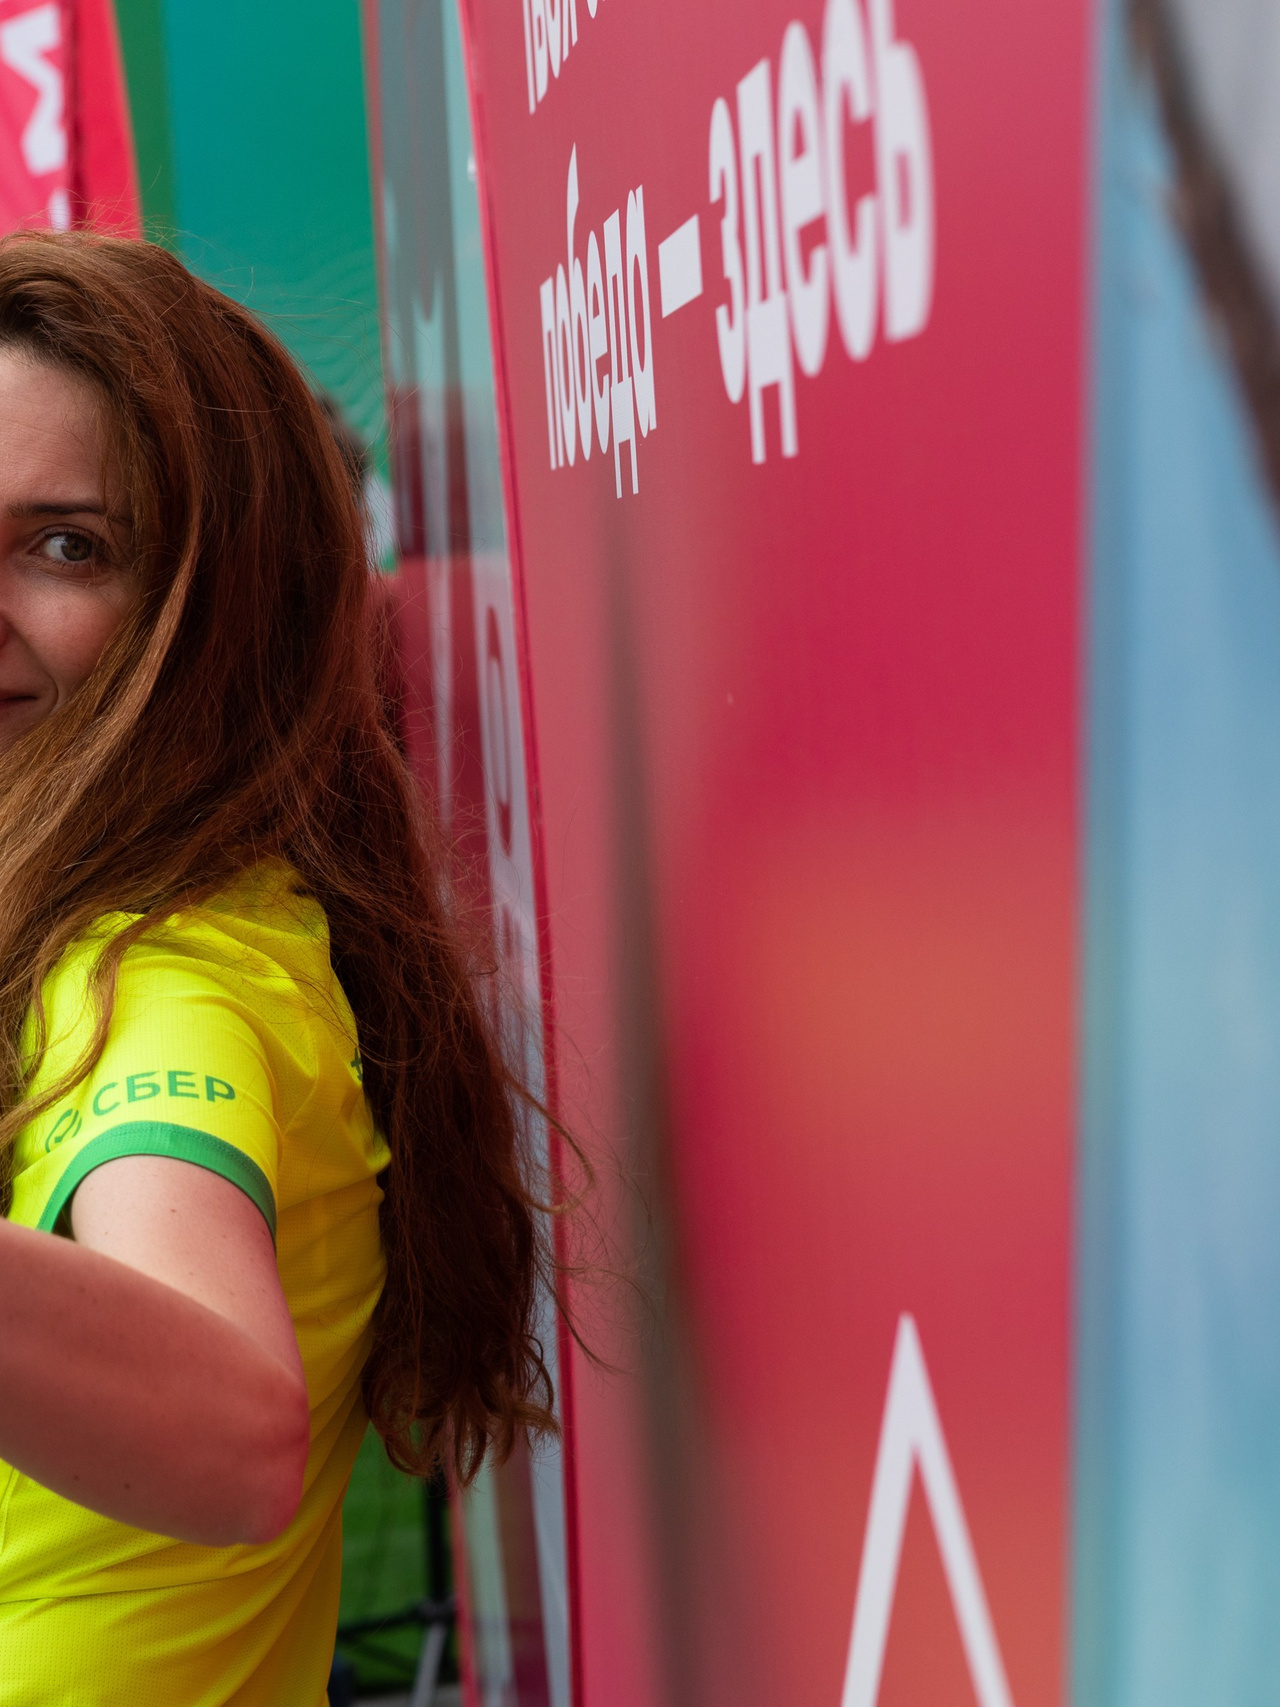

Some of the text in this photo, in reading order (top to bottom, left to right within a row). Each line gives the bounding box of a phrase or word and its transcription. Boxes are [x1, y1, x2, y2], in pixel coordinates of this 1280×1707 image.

[540, 141, 657, 499] победа
[709, 0, 937, 466] здесь
[92, 1070, 236, 1117] СБЕР
